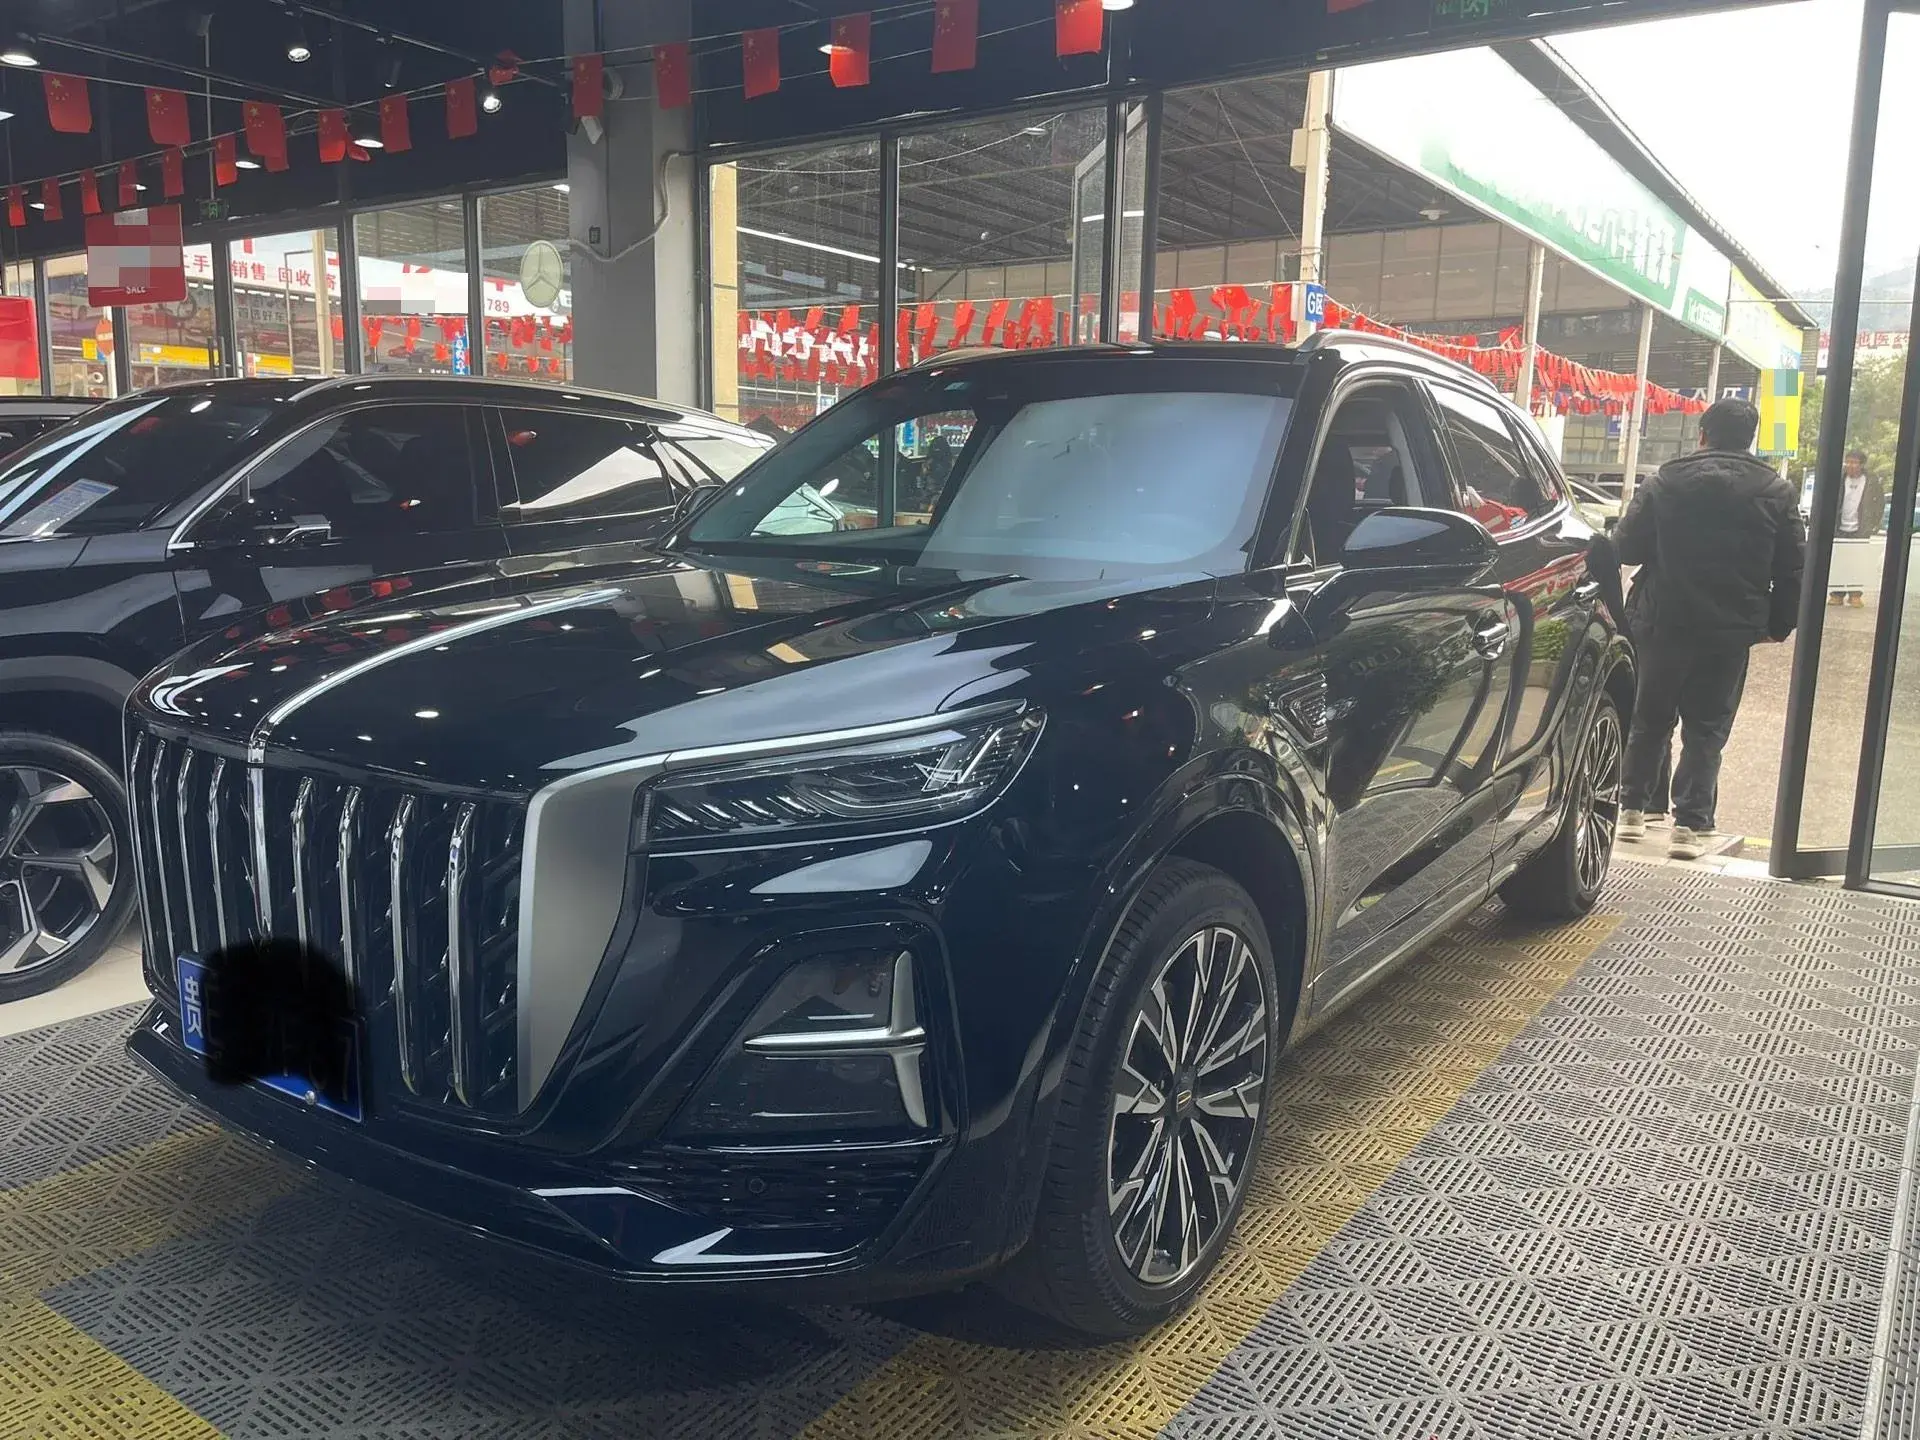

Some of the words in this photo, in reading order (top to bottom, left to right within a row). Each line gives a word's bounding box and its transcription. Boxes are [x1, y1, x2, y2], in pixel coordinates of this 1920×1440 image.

[231, 259, 266, 281] 销售
[278, 266, 312, 287] 回收
[1307, 291, 1324, 315] G区
